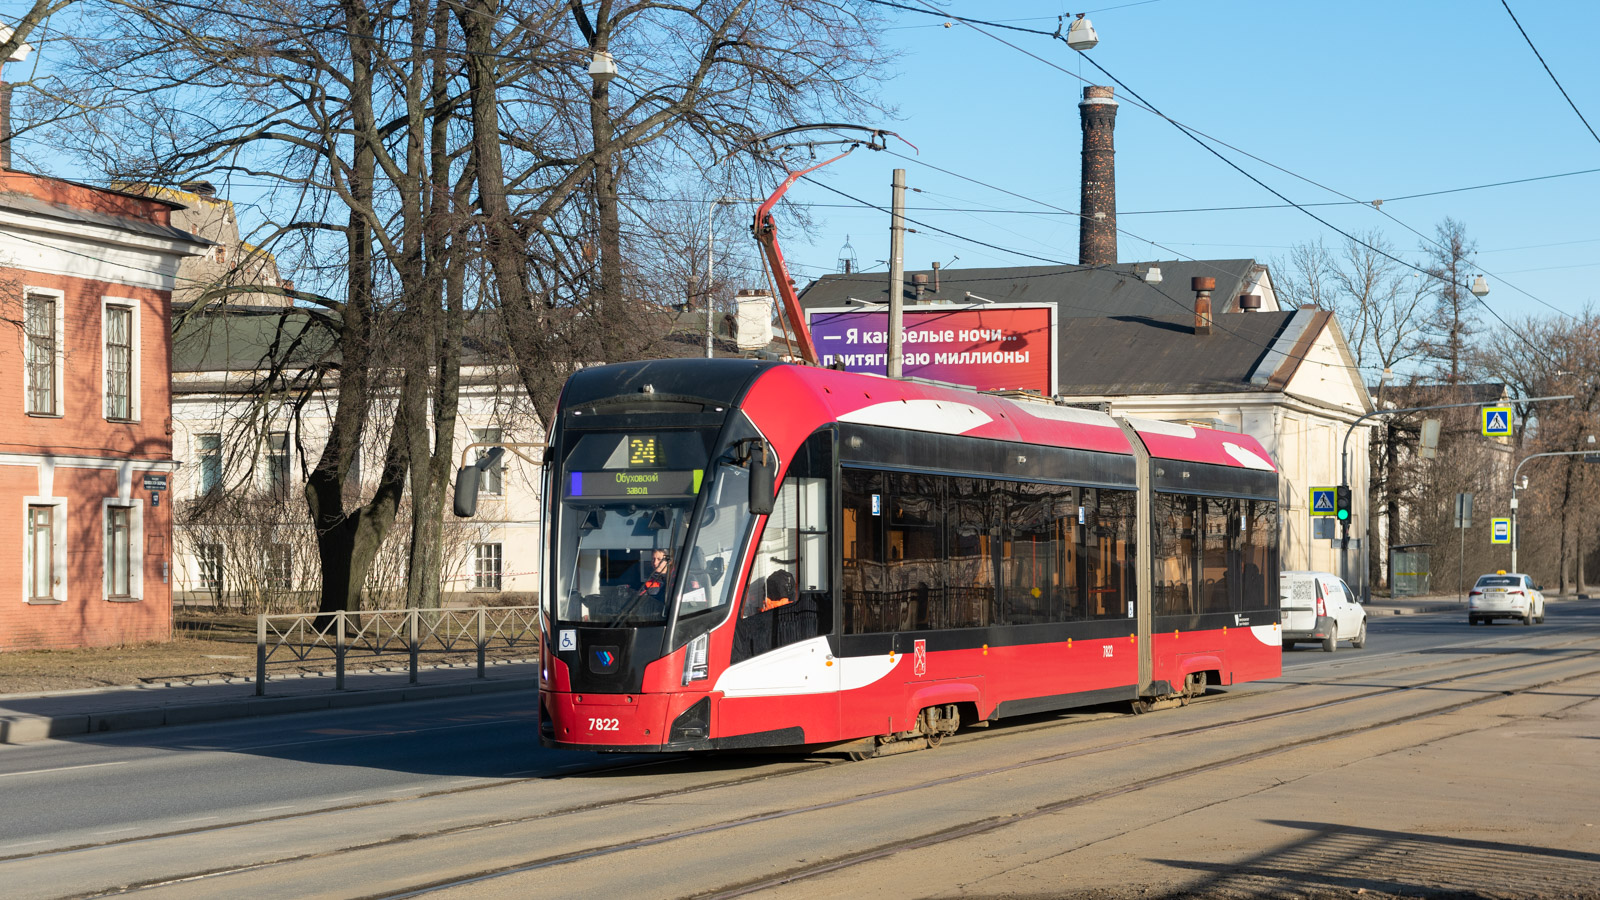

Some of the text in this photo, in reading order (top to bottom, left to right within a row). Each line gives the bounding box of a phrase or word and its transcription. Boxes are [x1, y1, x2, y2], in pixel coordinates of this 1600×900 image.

[846, 328, 858, 344] Я
[934, 351, 1030, 365] миллионы
[630, 438, 656, 464] 24
[615, 472, 658, 484] Обуховский
[626, 486, 648, 495] завод
[1102, 645, 1114, 658] 7822
[588, 718, 620, 731] 7822
